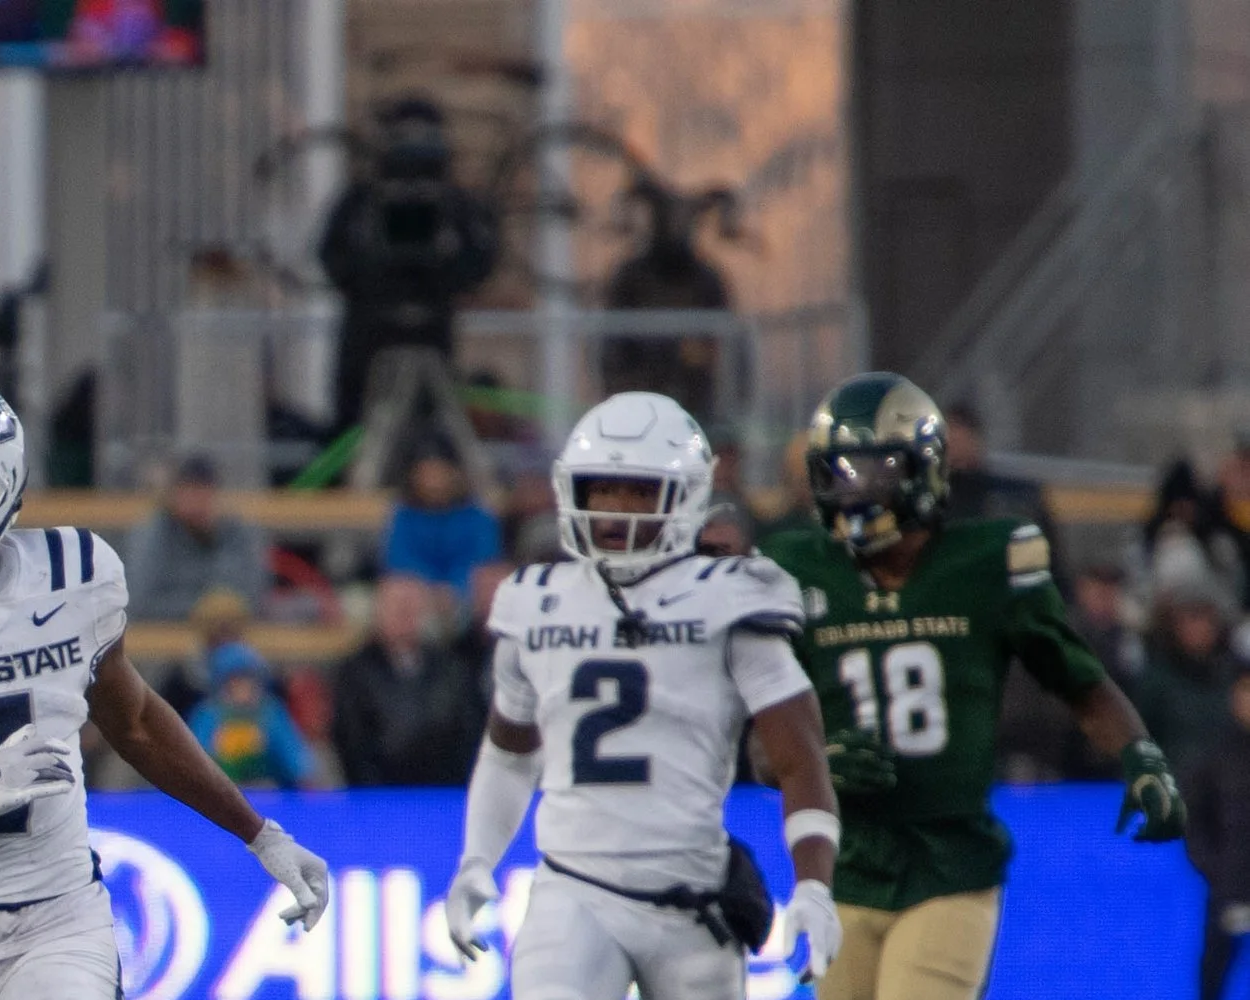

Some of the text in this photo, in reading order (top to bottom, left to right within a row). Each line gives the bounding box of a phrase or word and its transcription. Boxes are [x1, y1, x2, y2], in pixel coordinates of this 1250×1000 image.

[528, 625, 600, 651] UTAH
[911, 616, 970, 637] STATE
[570, 659, 651, 786] 2
[838, 641, 948, 756] 18
